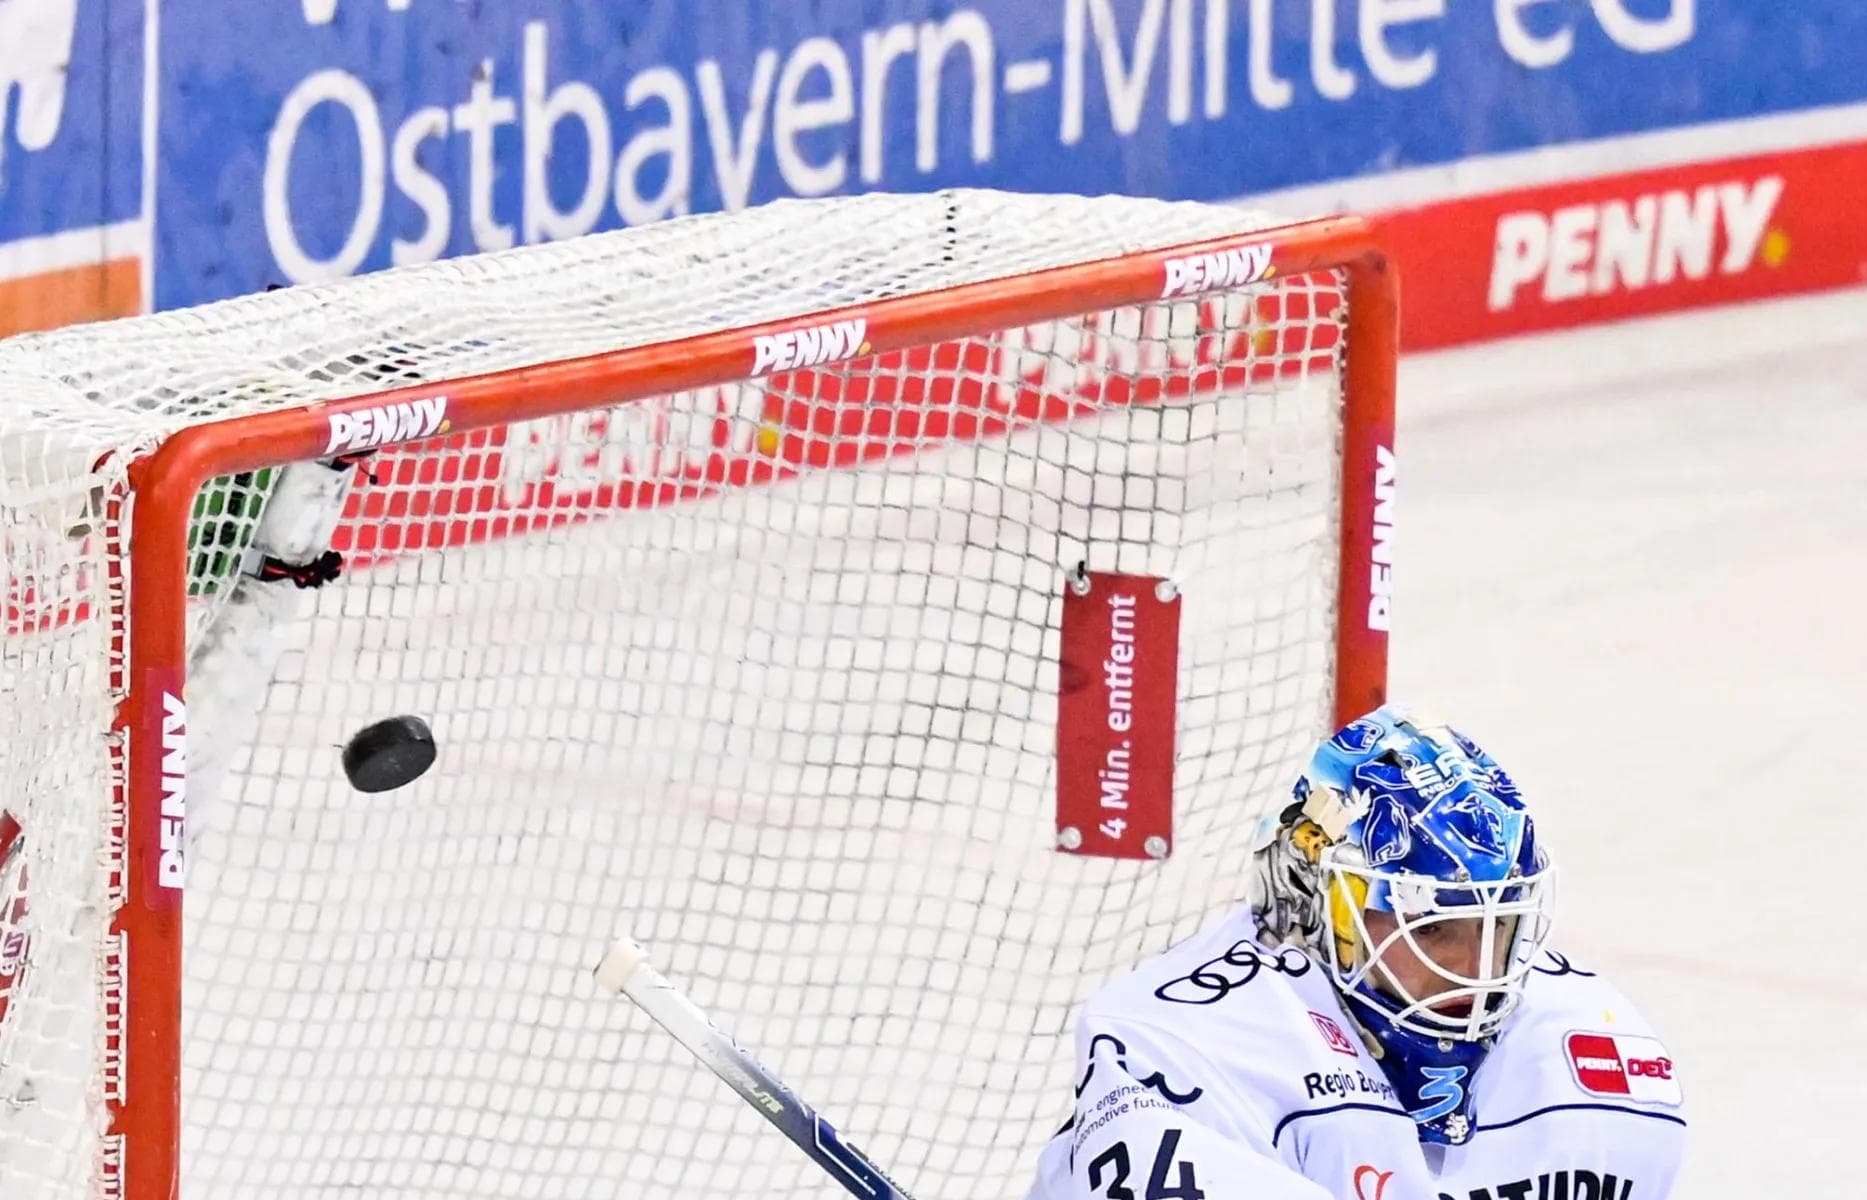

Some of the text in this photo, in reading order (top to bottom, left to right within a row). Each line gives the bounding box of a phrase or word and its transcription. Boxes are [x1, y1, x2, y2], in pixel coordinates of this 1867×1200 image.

[1099, 593, 1137, 840] 4 Min. entfernt
[1303, 1067, 1356, 1100] Regio
